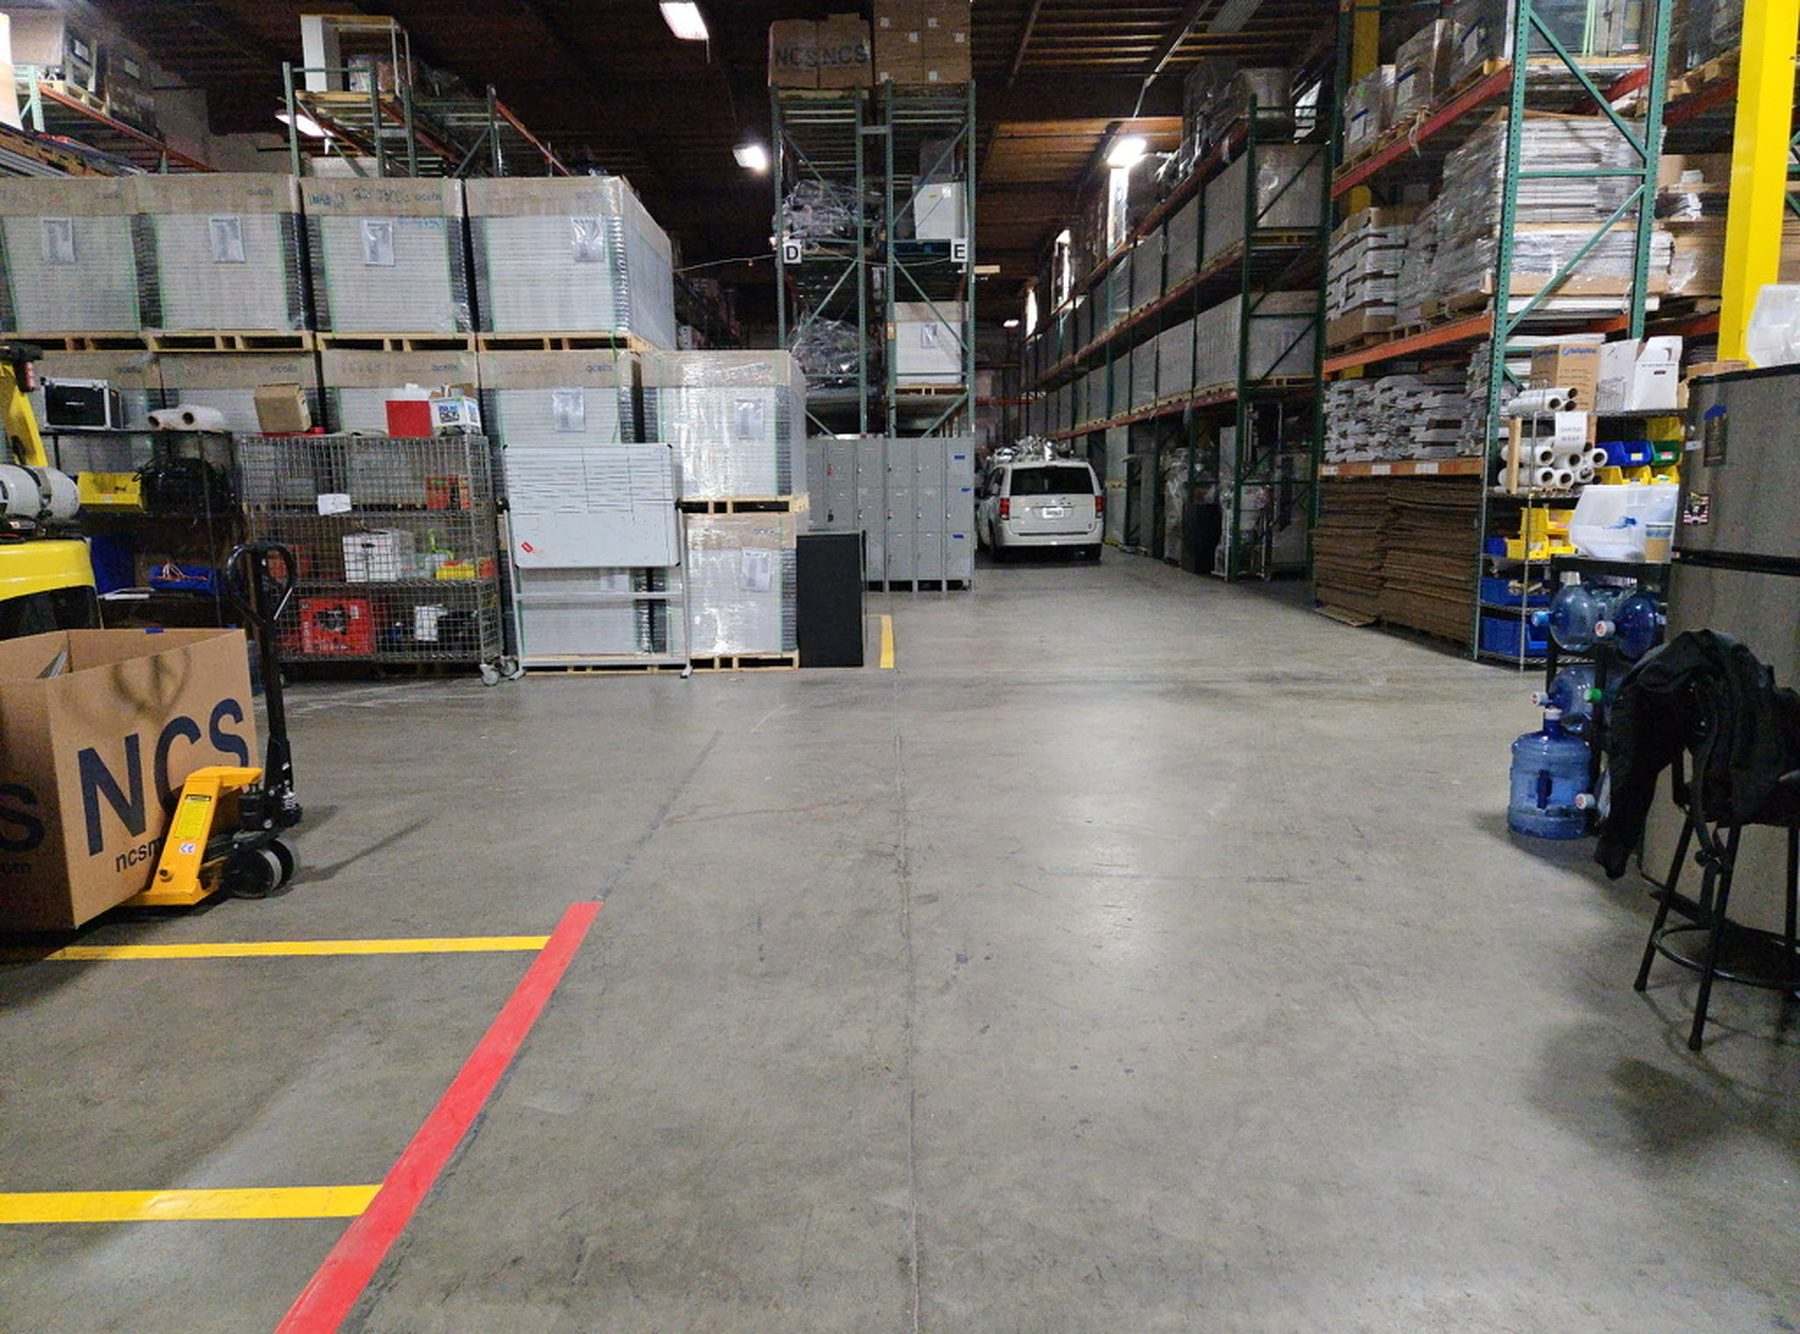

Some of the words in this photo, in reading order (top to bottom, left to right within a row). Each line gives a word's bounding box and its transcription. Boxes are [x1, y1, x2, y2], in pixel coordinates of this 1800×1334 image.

[774, 45, 816, 67] NCS
[823, 43, 868, 64] NCS
[786, 245, 799, 260] D
[954, 244, 966, 259] E
[78, 698, 249, 857] NCS
